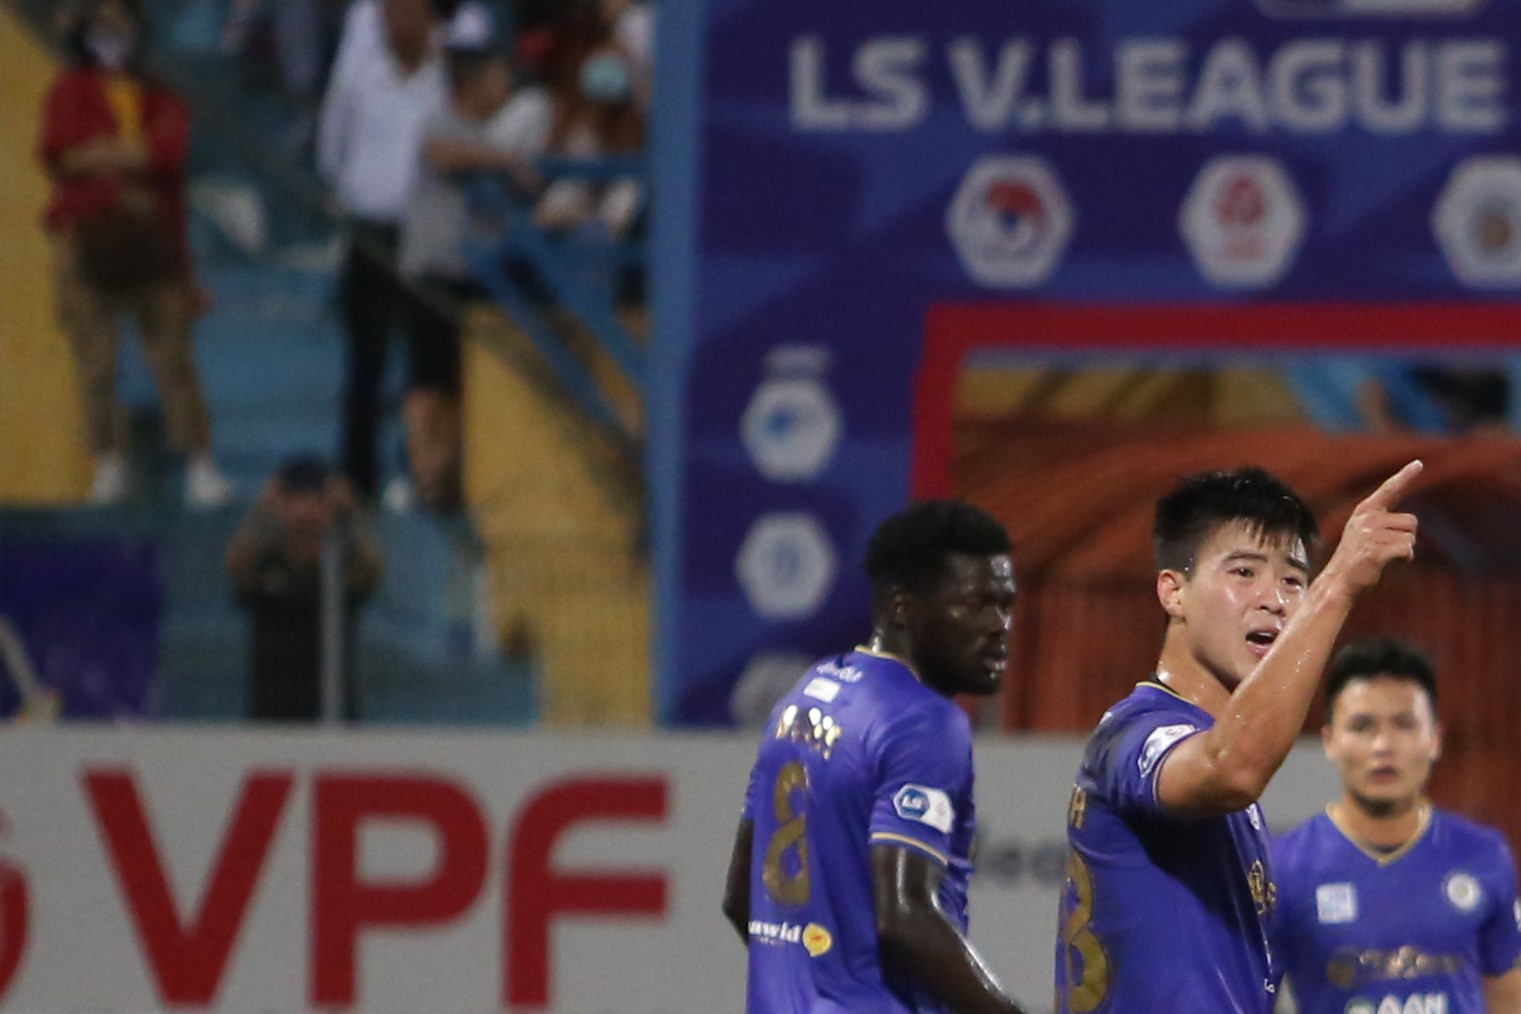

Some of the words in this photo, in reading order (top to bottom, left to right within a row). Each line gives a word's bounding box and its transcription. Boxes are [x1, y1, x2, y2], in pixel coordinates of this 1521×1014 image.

[791, 37, 928, 129] LS
[947, 37, 1506, 131] V.LEAGUE
[80, 765, 672, 1014] VPF
